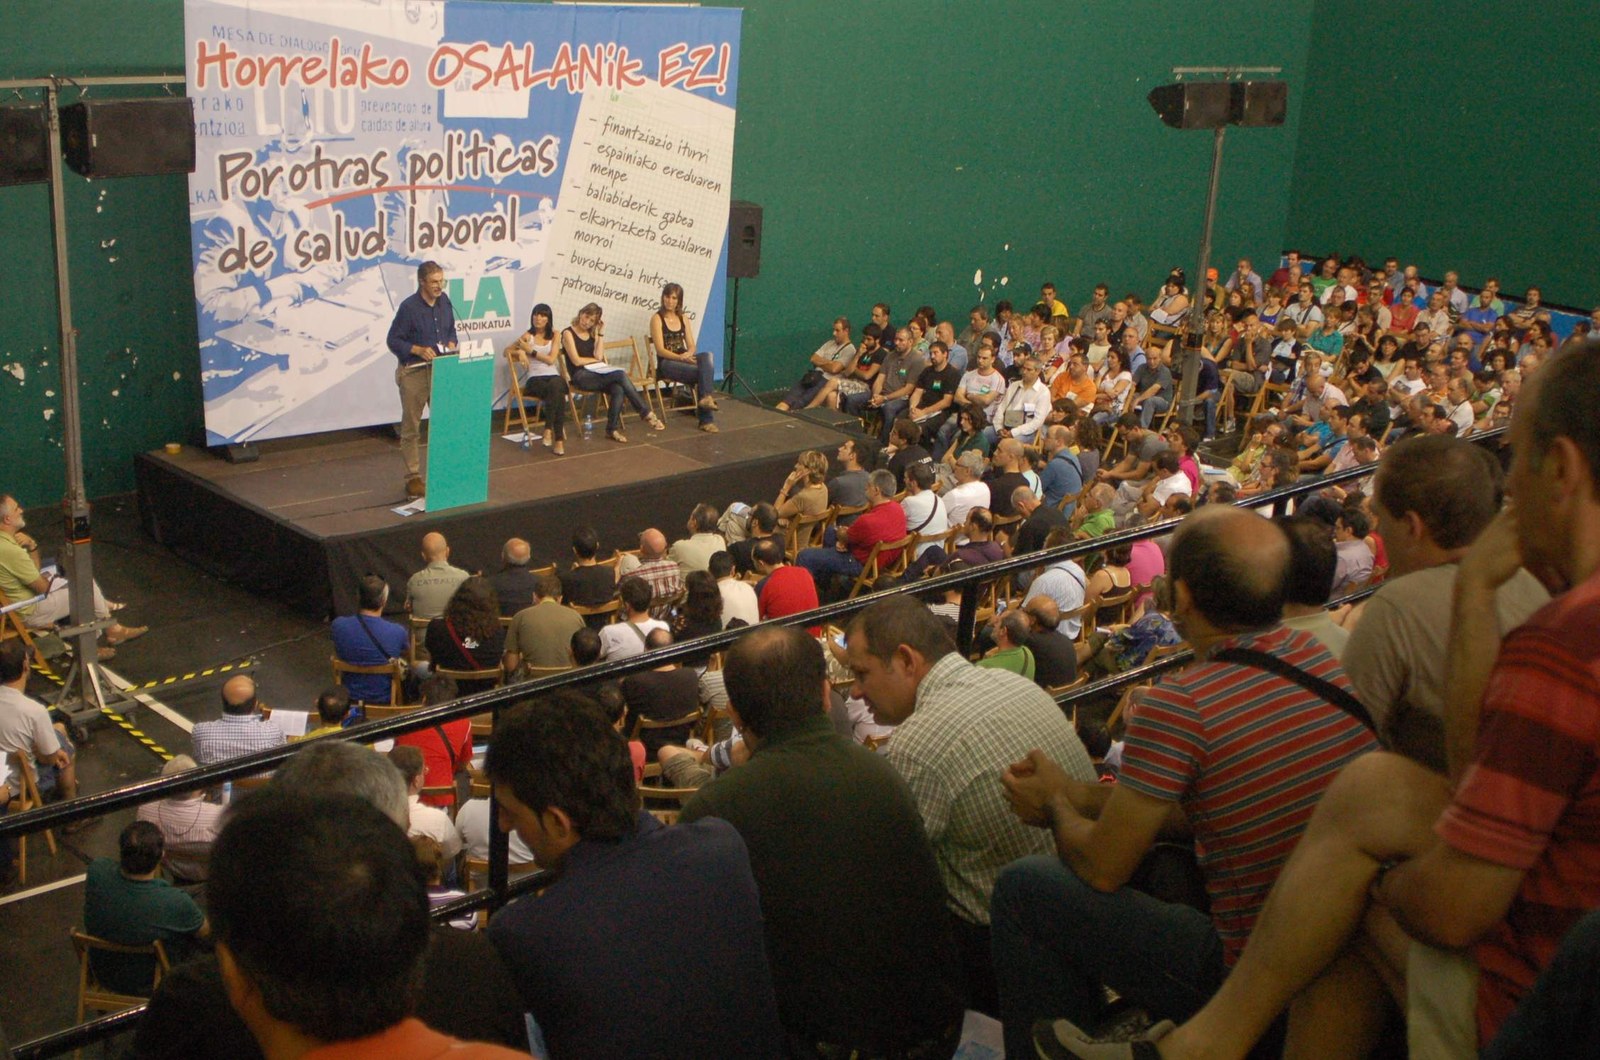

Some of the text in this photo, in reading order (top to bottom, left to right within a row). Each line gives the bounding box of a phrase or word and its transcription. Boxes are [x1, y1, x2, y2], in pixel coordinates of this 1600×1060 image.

[212, 25, 255, 42] MESA
[259, 32, 274, 46] DE
[197, 38, 409, 90] Horrelako
[659, 45, 729, 93] EZ!
[421, 102, 432, 115] de
[601, 115, 709, 163] finantziazio iturri
[218, 152, 283, 201] Por
[289, 145, 389, 190] otras
[590, 163, 628, 186] menpe
[597, 143, 721, 193] espainiako ereduaren
[586, 183, 694, 231] baliabiderik gabea
[217, 197, 517, 274] de salud laboral
[573, 230, 614, 250] morroi
[579, 207, 713, 259] elkarrizketa sozialaren
[570, 250, 634, 280] burokrazia
[446, 276, 511, 320] LA
[561, 275, 628, 304] patronalaren
[456, 319, 512, 332] SINDIKATUA
